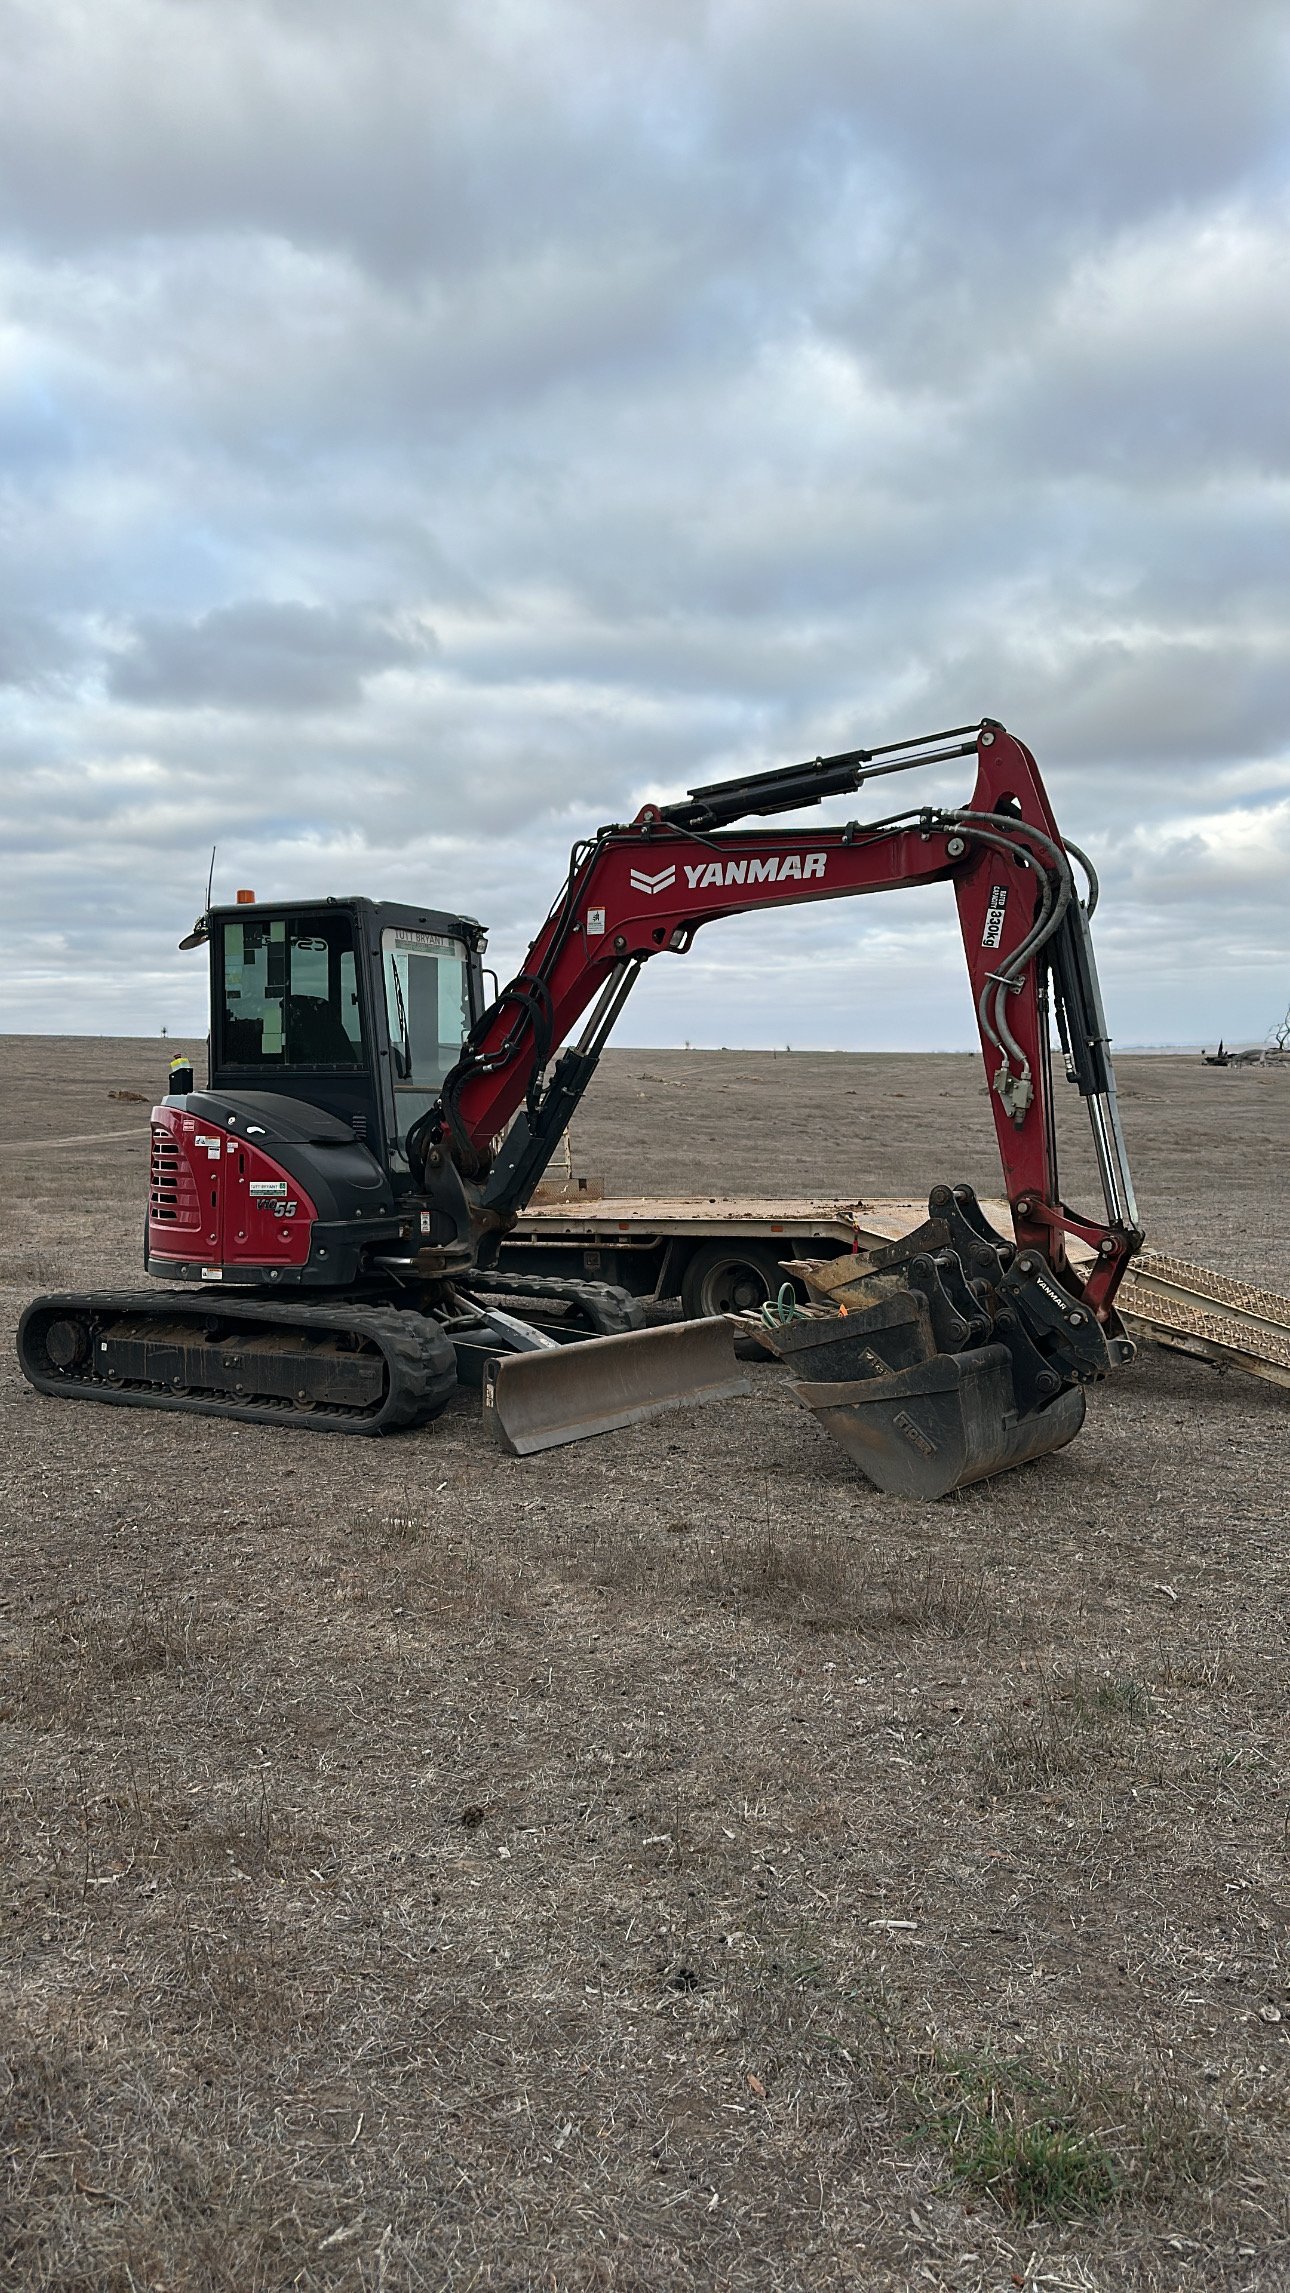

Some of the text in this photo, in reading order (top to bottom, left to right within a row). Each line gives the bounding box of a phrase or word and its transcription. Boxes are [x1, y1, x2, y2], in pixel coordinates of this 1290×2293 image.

[683, 852, 828, 889] YANMAR
[415, 933, 444, 946] BRYANT
[982, 910, 1002, 947] 330kg
[273, 1201, 298, 1218] 55
[1036, 1277, 1067, 1310] YANMAR
